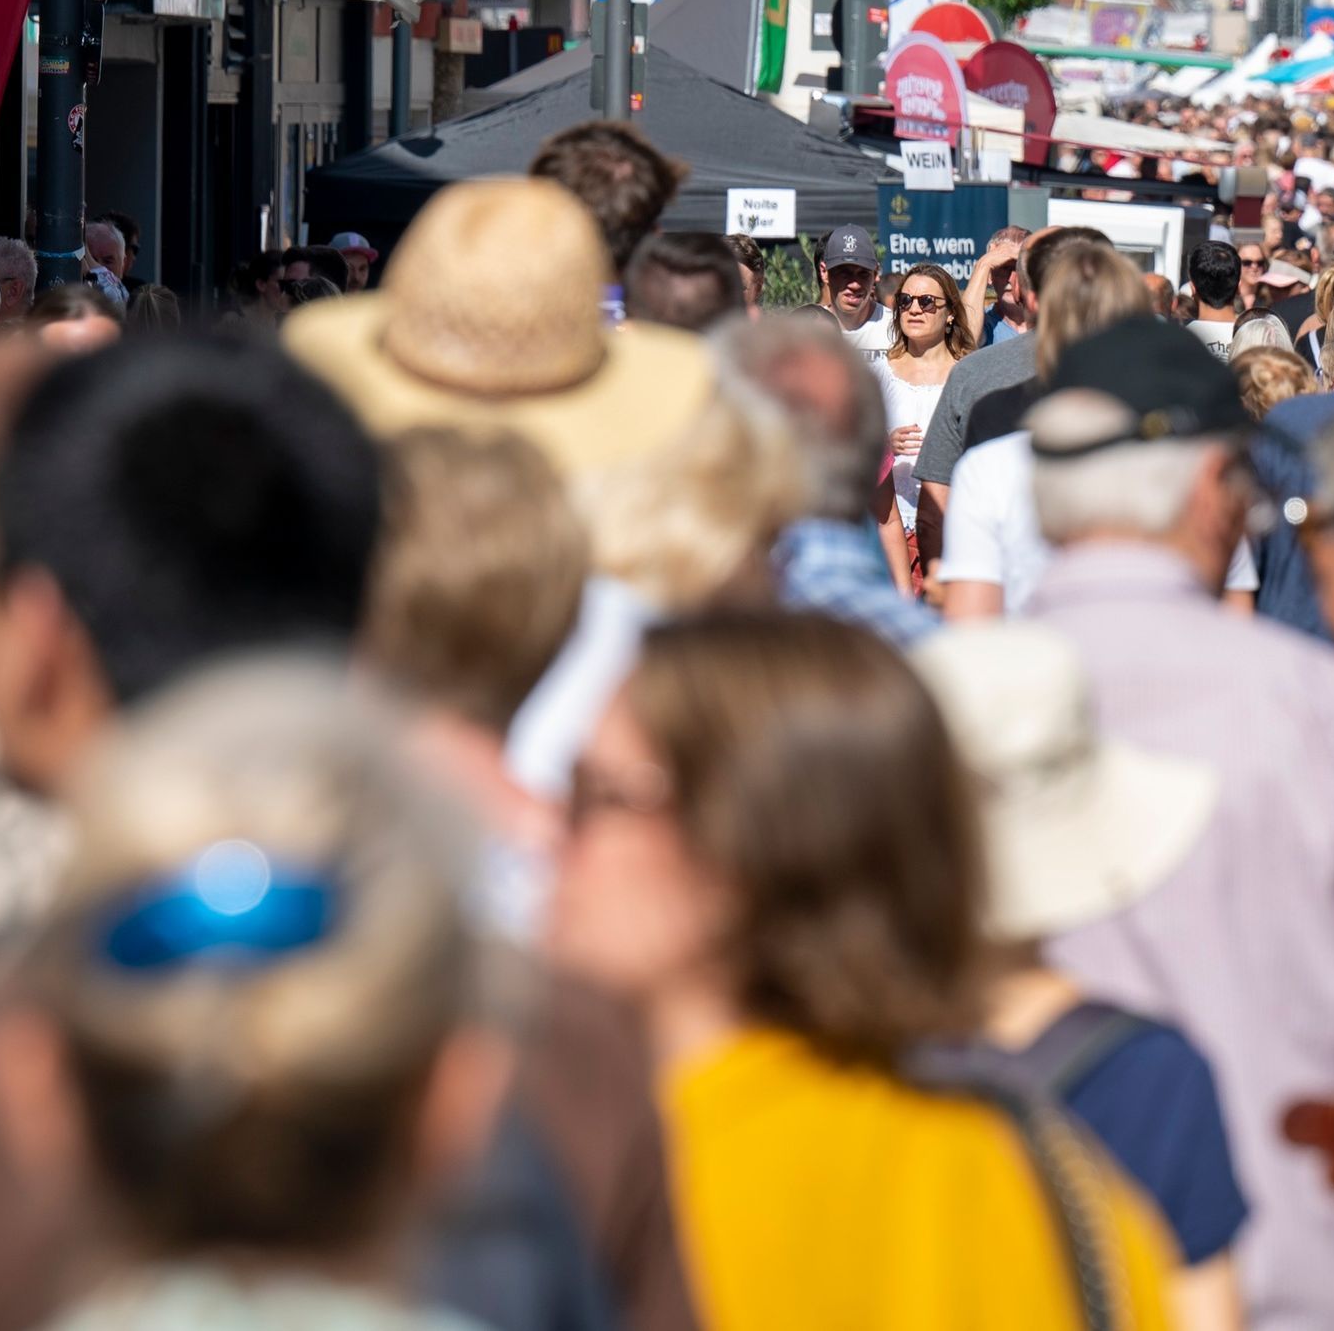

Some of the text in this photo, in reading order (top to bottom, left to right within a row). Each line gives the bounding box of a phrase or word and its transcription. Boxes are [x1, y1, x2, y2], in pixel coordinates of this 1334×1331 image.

[906, 152, 947, 169] WEIN
[889, 233, 975, 258] Ehre, wem
